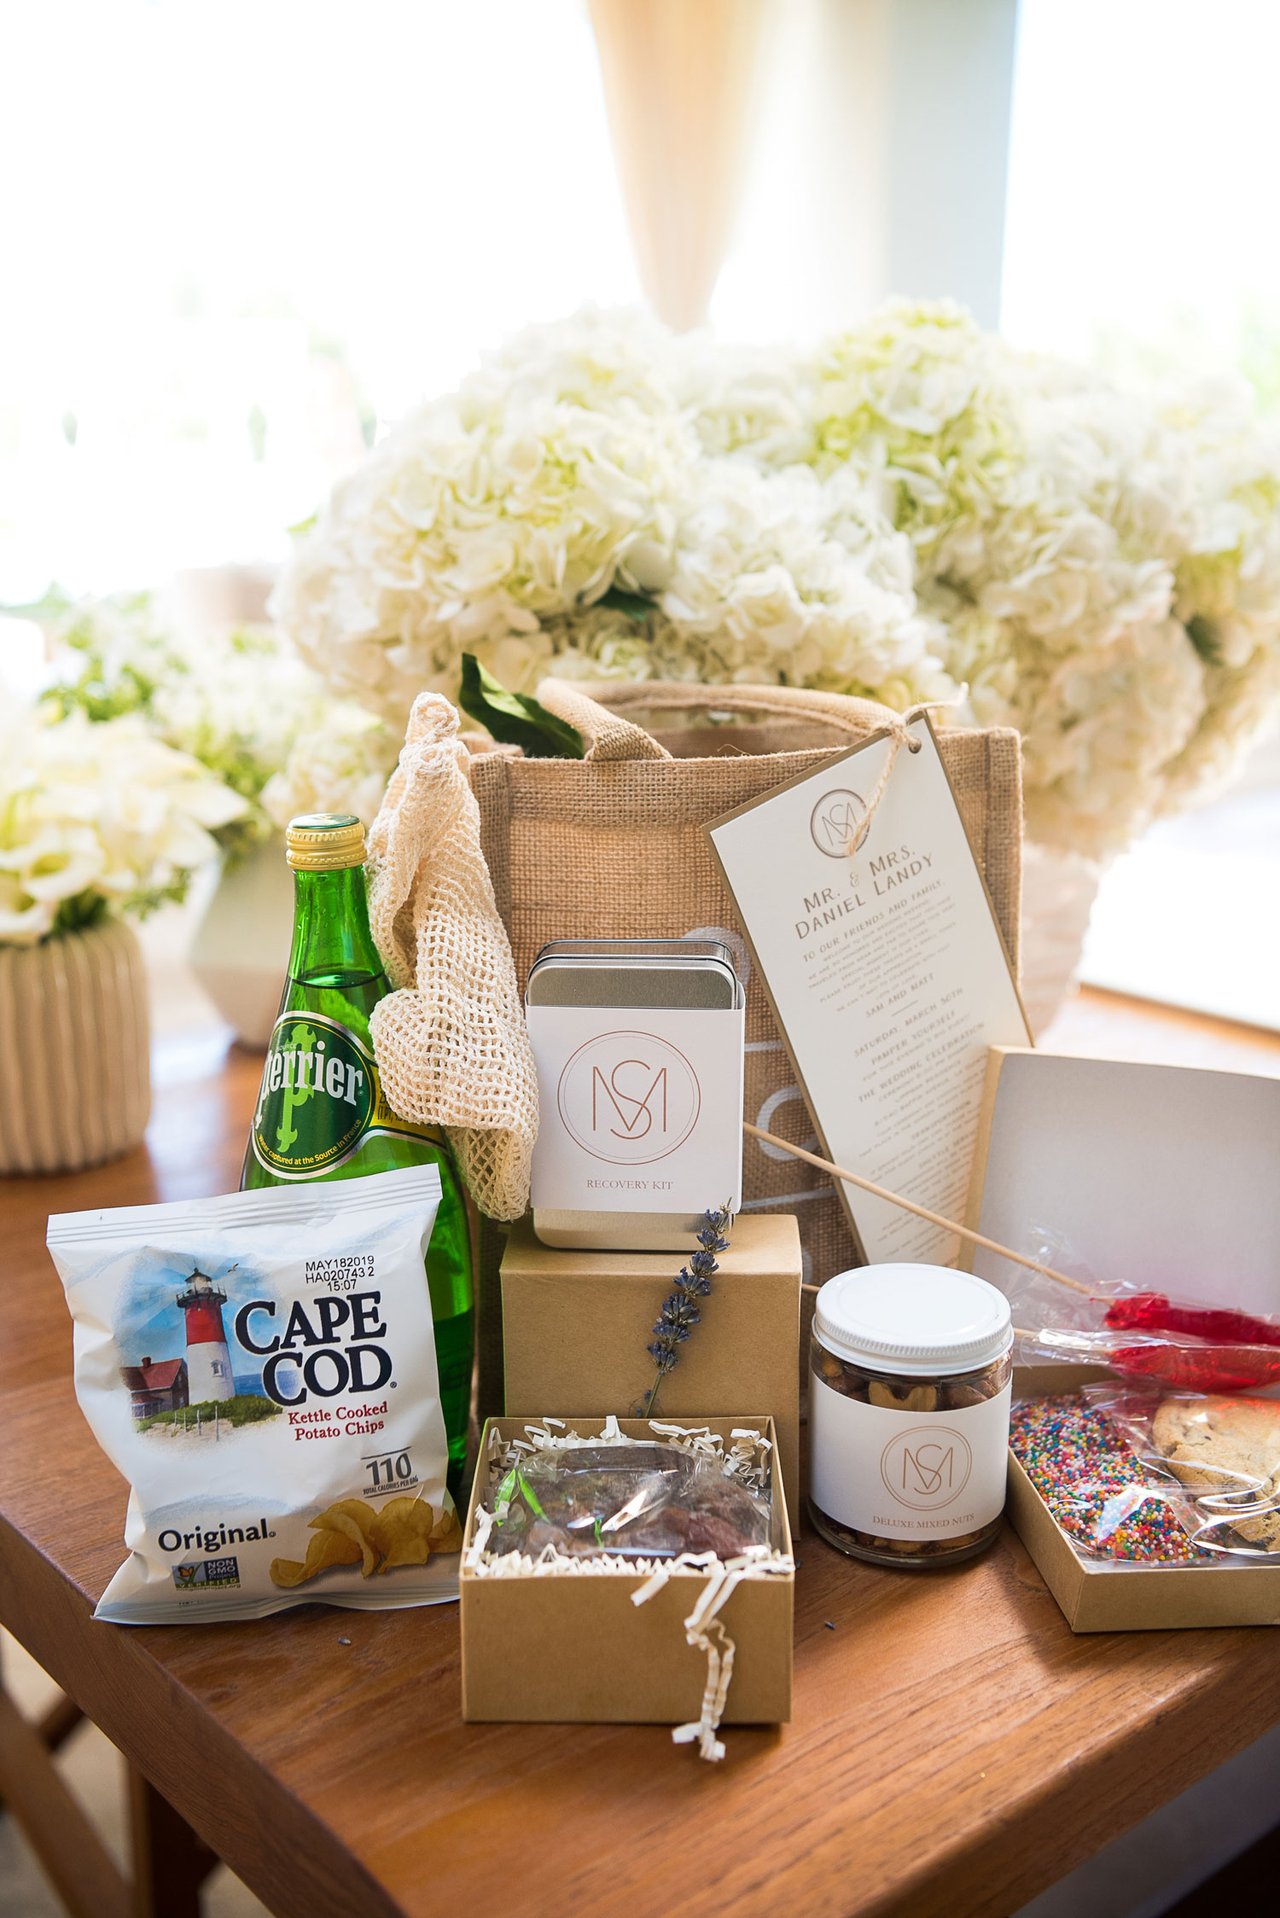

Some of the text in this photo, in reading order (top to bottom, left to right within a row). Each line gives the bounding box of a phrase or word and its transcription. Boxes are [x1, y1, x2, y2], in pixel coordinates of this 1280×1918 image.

[803, 844, 917, 913] MR. & MRS.
[794, 855, 931, 939] DANIEL LANDY
[803, 951, 815, 962] TO
[819, 937, 839, 952] OUR
[843, 912, 883, 939] FRIENDS
[888, 899, 907, 913] AND
[864, 1003, 883, 1016] SAM
[888, 990, 906, 1004] AND
[910, 972, 933, 990] MATT
[904, 1004, 936, 1026] MARCH
[871, 1039, 906, 1065] PAMPER
[911, 1010, 954, 1039] YOURSELF
[858, 1089, 874, 1102] THE
[879, 1061, 921, 1089] WEDDING
[925, 1022, 984, 1061] CELEBRATION
[268, 1149, 293, 1165] captured
[294, 1156, 302, 1165] at
[302, 1155, 315, 1164] the
[315, 1145, 339, 1161] Source
[343, 1118, 362, 1143] France
[586, 1178, 674, 1191] RECOVERY KIT
[327, 1279, 357, 1292] 15:07
[235, 1291, 387, 1354] CAPE
[263, 1344, 393, 1406] COD
[288, 1401, 389, 1426] Kettle Cooked
[295, 1419, 385, 1441] Potato Chips
[366, 1453, 412, 1486] 110
[363, 1487, 377, 1495] TOTAL
[158, 1518, 268, 1553] Original
[872, 1512, 975, 1529] DELUXE MIXED NUTS
[207, 1559, 234, 1570] NON
[208, 1565, 236, 1576] GMO
